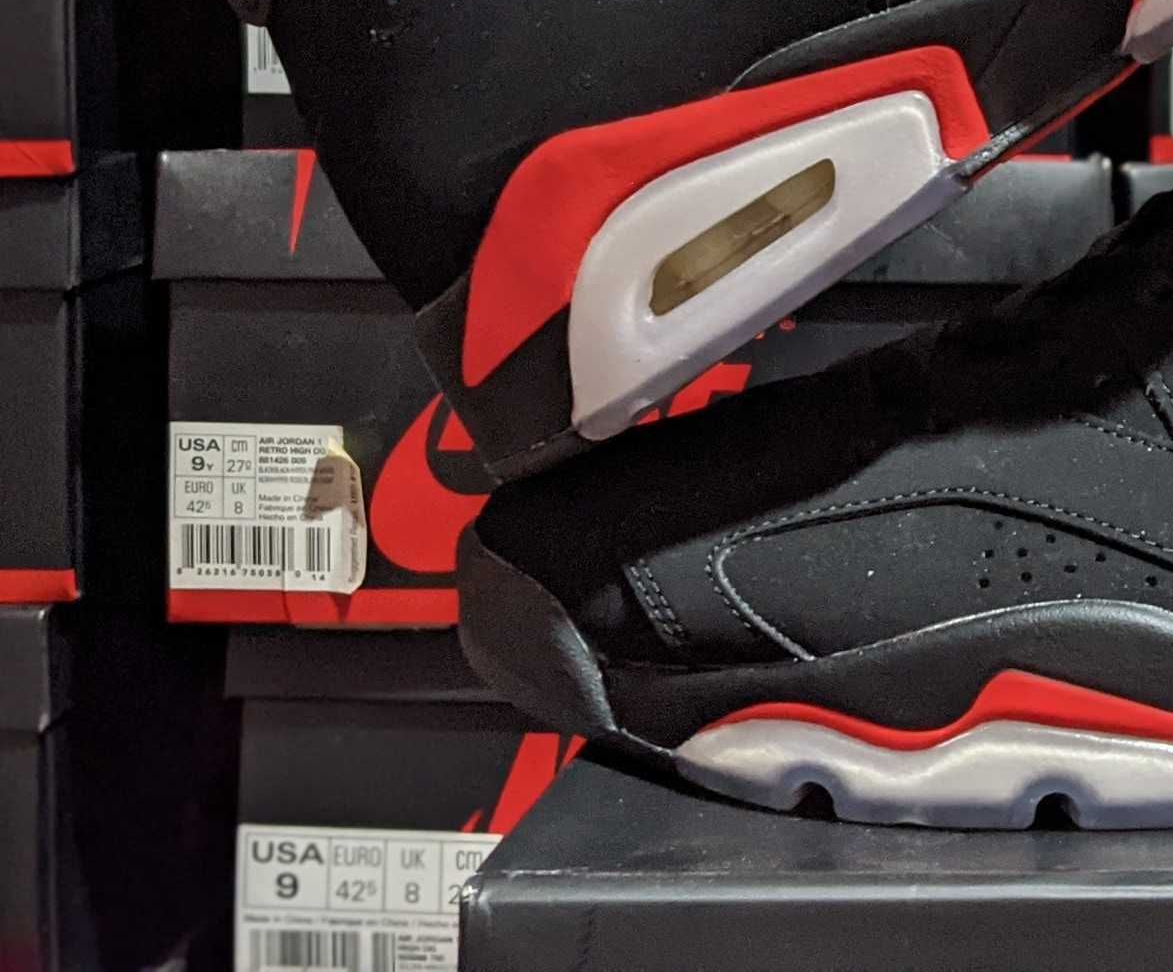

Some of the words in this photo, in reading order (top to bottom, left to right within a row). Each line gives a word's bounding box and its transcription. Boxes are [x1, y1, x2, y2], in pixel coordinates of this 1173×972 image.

[178, 438, 221, 452] USA
[231, 440, 249, 452] cm
[259, 437, 275, 445] AIR
[277, 437, 315, 446] JORDAN
[259, 446, 288, 455] RETRO
[290, 446, 312, 455] HIGH
[184, 481, 214, 495] EURO
[231, 482, 247, 494] UK
[259, 493, 281, 502] Made
[284, 494, 291, 502] in
[233, 501, 244, 515] 8
[259, 503, 293, 513] Fabrique
[259, 513, 285, 522] Hecho
[252, 840, 324, 865] USA
[333, 844, 382, 867] EURO
[401, 848, 426, 870] UK
[275, 872, 299, 900] 9
[404, 882, 420, 905] 8
